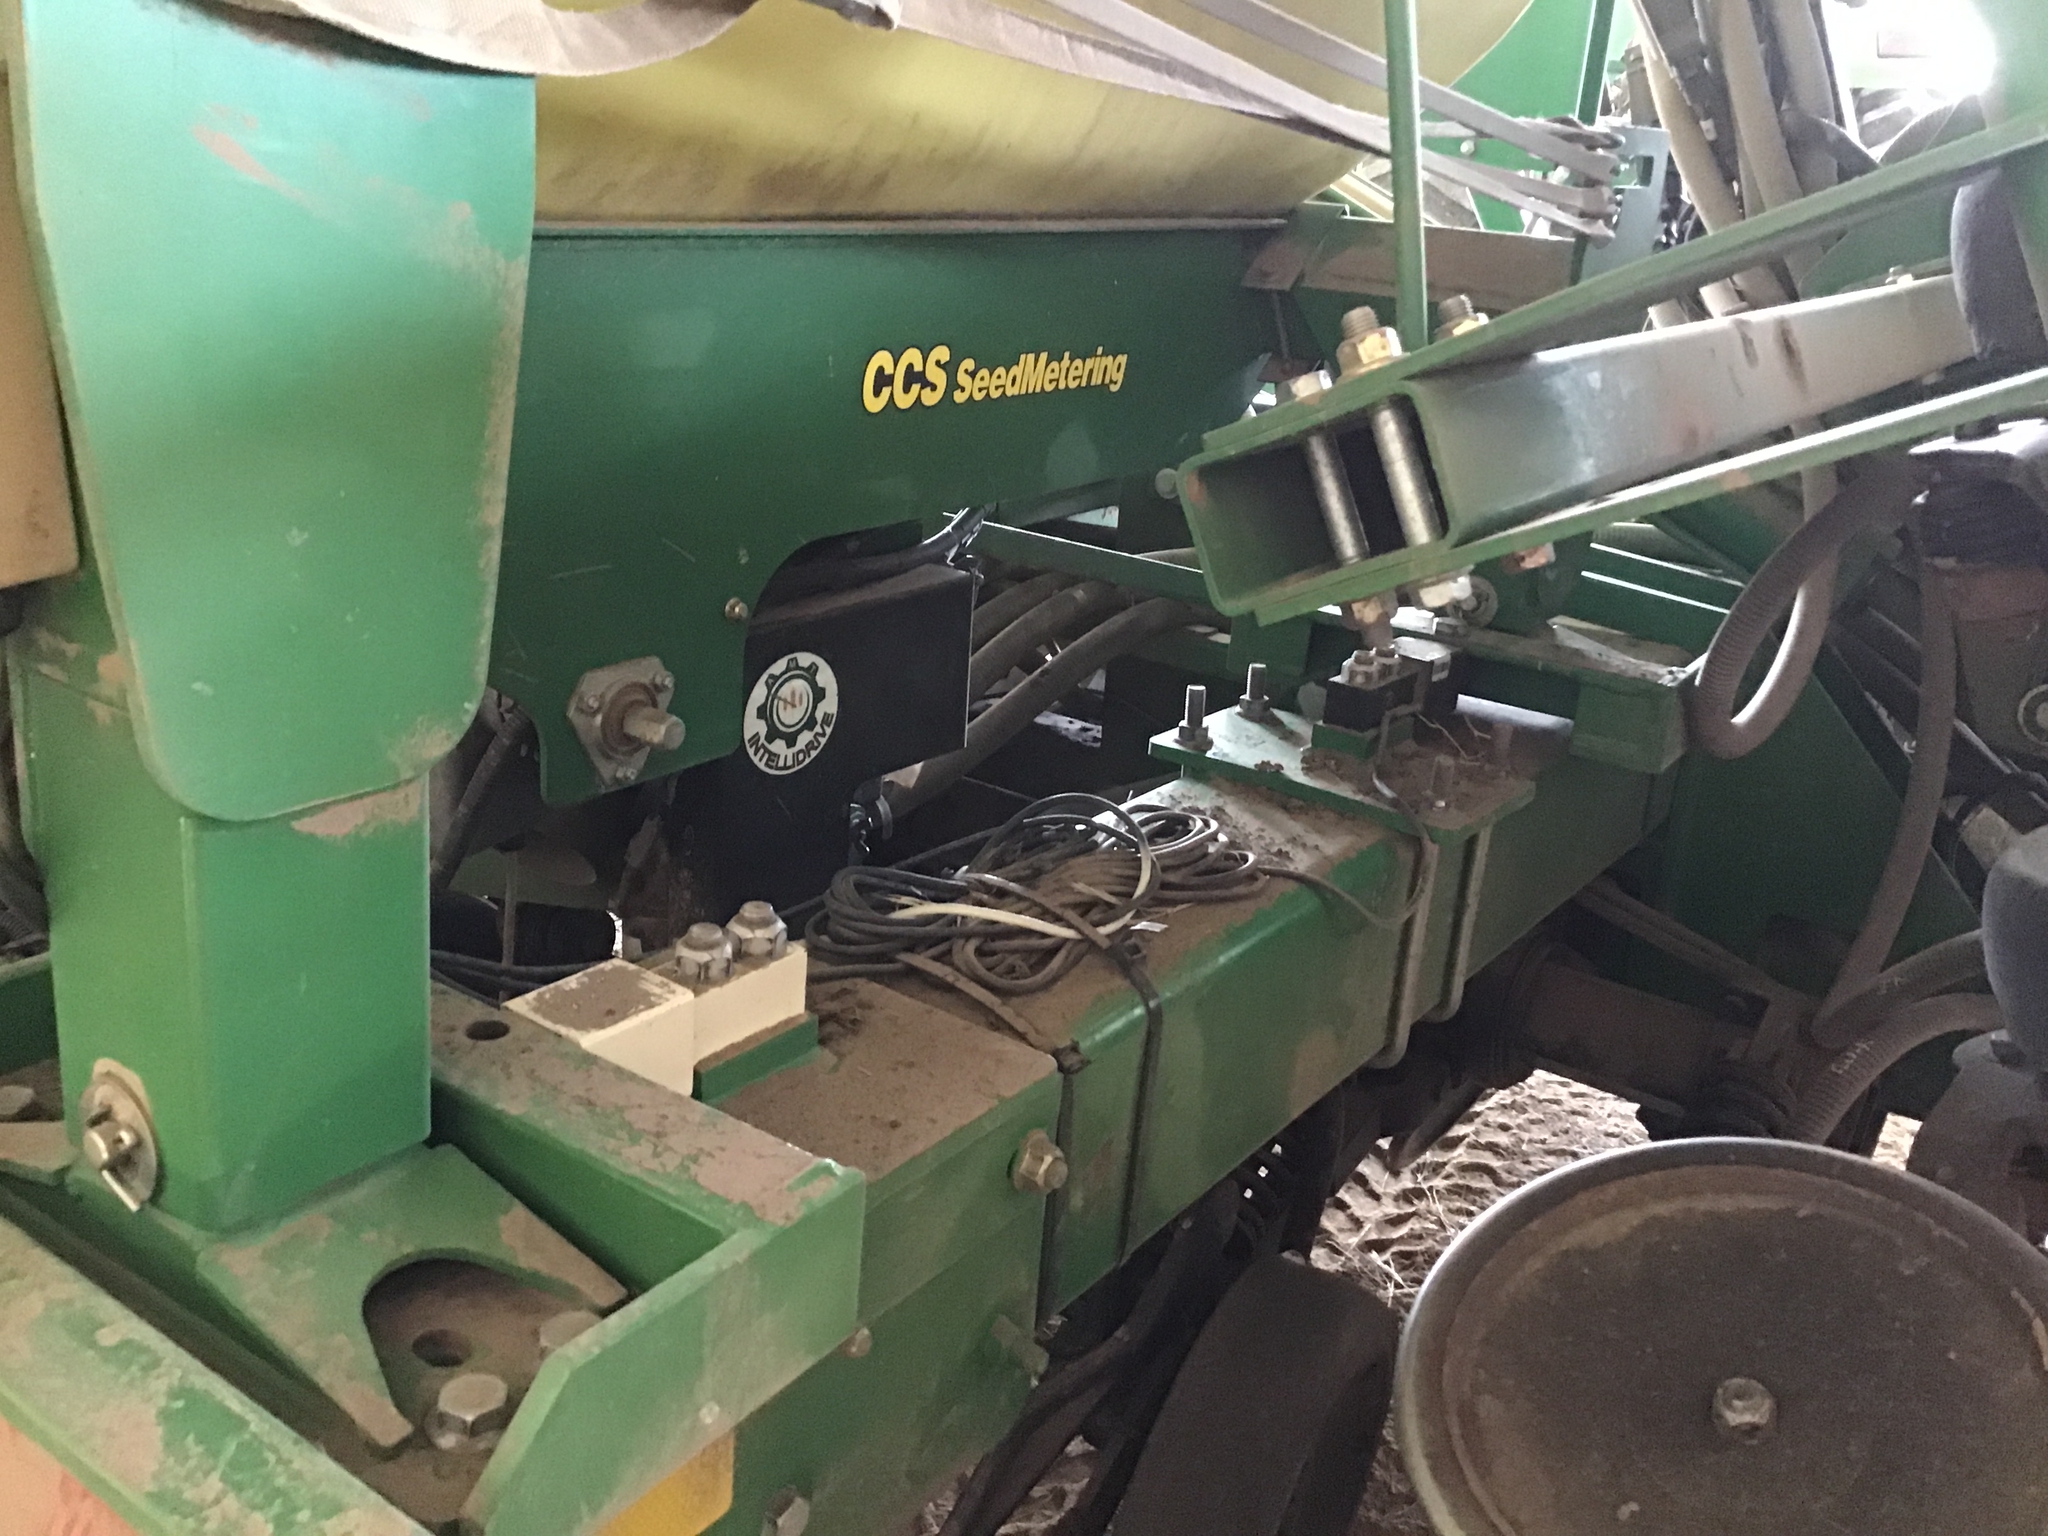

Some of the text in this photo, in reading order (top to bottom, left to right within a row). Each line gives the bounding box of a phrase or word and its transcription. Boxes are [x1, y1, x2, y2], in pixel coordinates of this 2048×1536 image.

[862, 345, 1128, 414] CCS SeedMetering
[747, 711, 835, 771] INTELLIDRIVE
